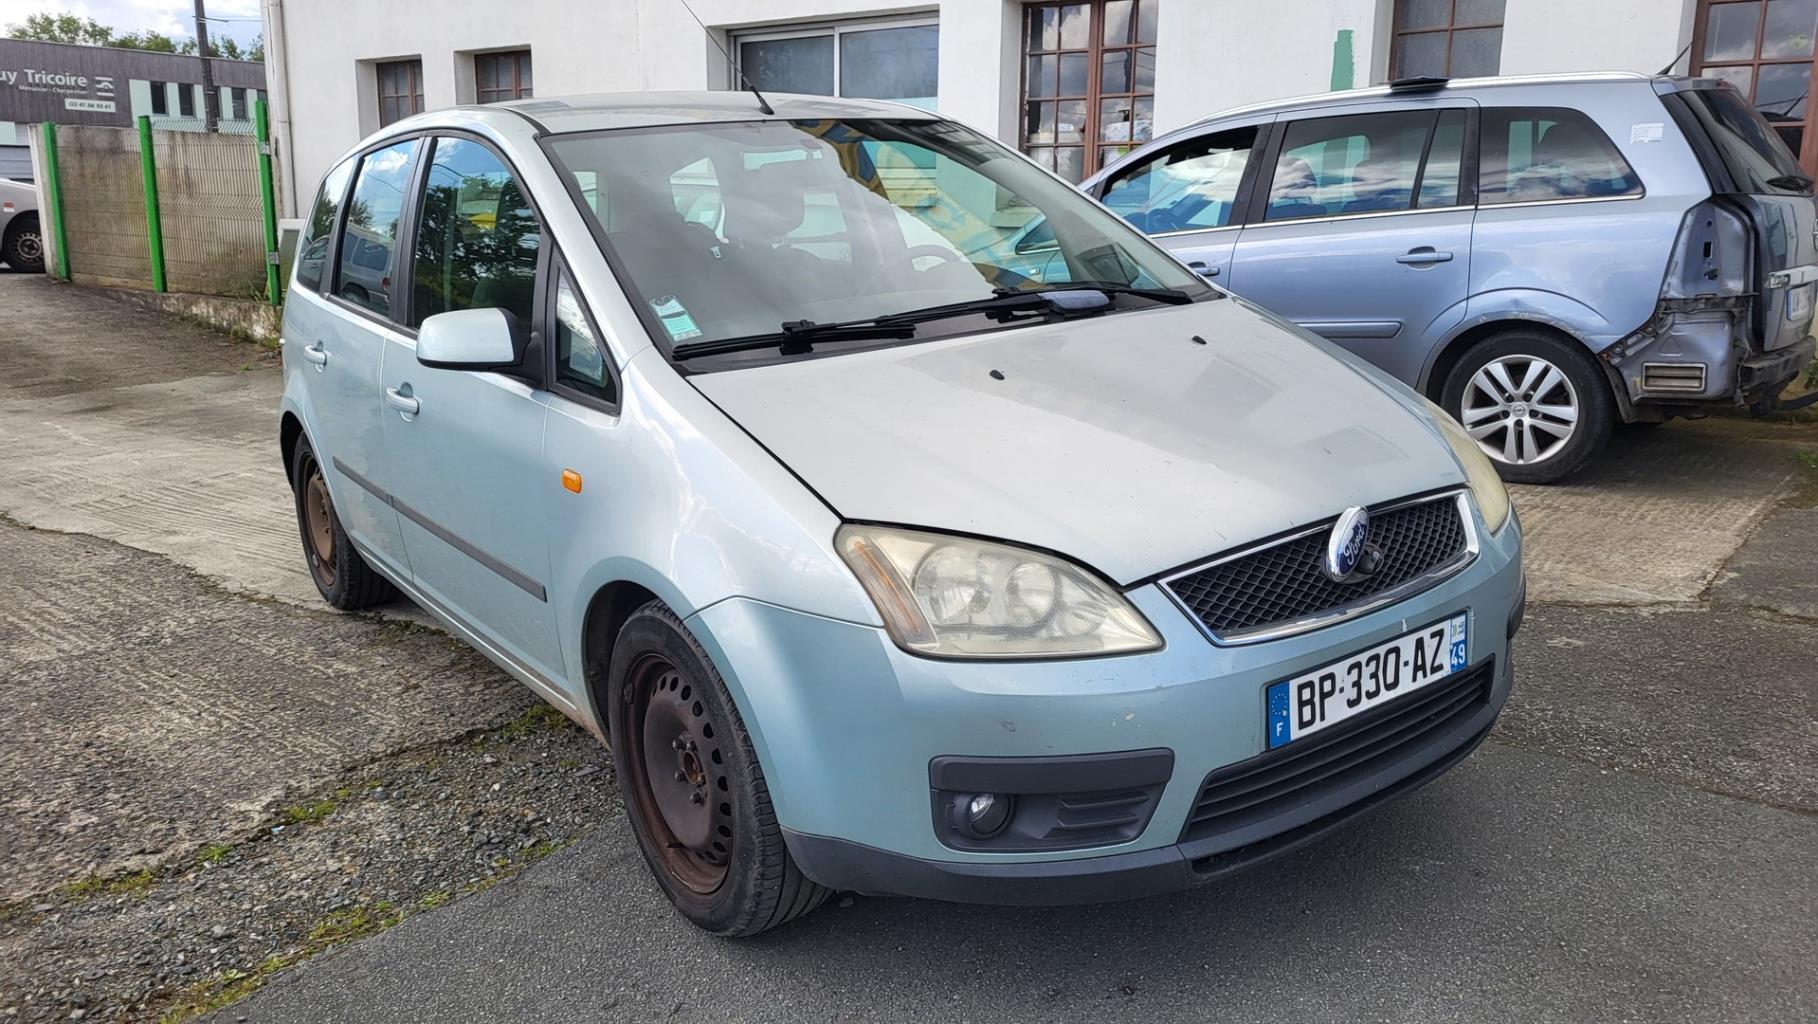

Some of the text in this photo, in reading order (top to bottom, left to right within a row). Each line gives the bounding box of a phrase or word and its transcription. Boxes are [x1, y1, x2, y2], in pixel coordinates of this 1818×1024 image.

[23, 68, 88, 87] Tricoire
[1451, 643, 1465, 665] 49
[1297, 627, 1445, 731] BP-330-AZ
[1276, 721, 1284, 737] F
